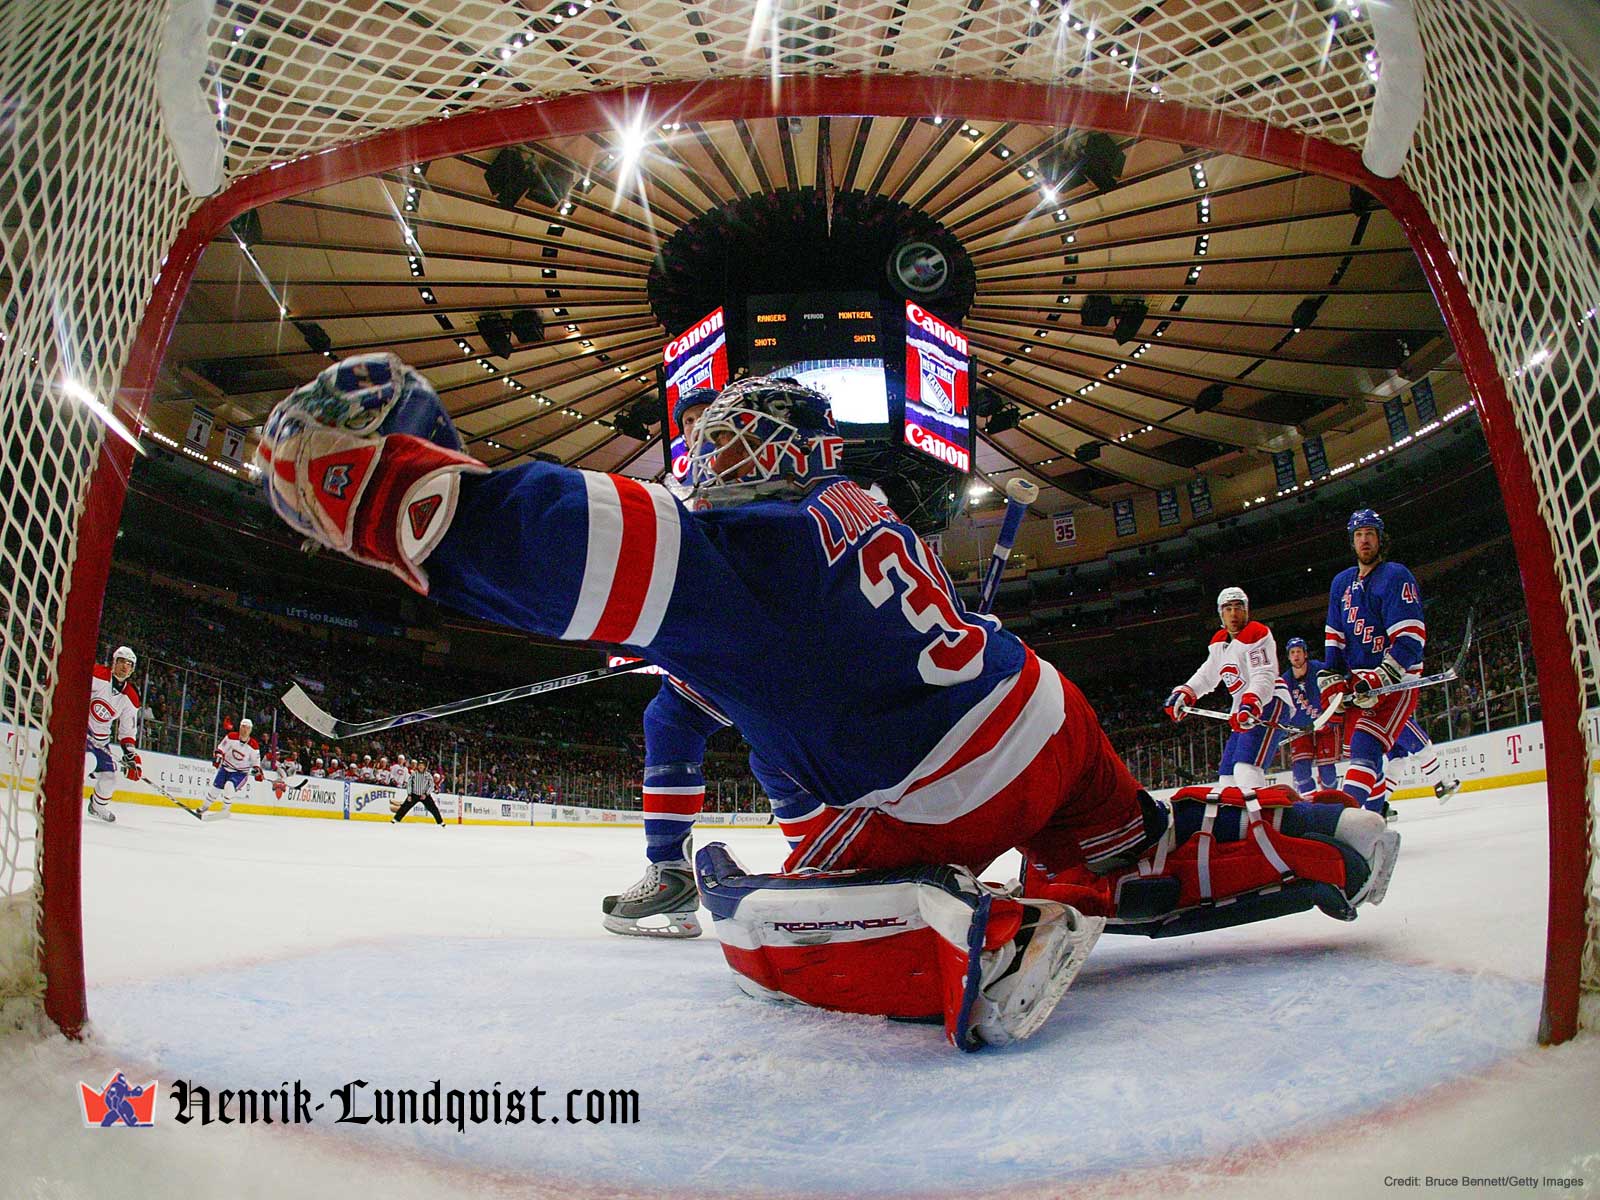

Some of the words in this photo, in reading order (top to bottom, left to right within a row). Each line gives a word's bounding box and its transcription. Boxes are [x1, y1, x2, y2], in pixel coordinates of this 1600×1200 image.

[757, 313, 787, 323] RANGERS
[838, 311, 874, 320] MONTREAL
[663, 309, 725, 364] Canon
[853, 334, 876, 343] SHOTS
[905, 302, 968, 356] Canon
[754, 338, 777, 347] SHOTS
[922, 357, 936, 374] NEW
[937, 364, 953, 381] YORK
[229, 438, 239, 458] 7
[904, 423, 969, 472] Canon
[1055, 523, 1074, 541] 35
[309, 612, 322, 621] GO
[355, 790, 397, 811] SABRETT
